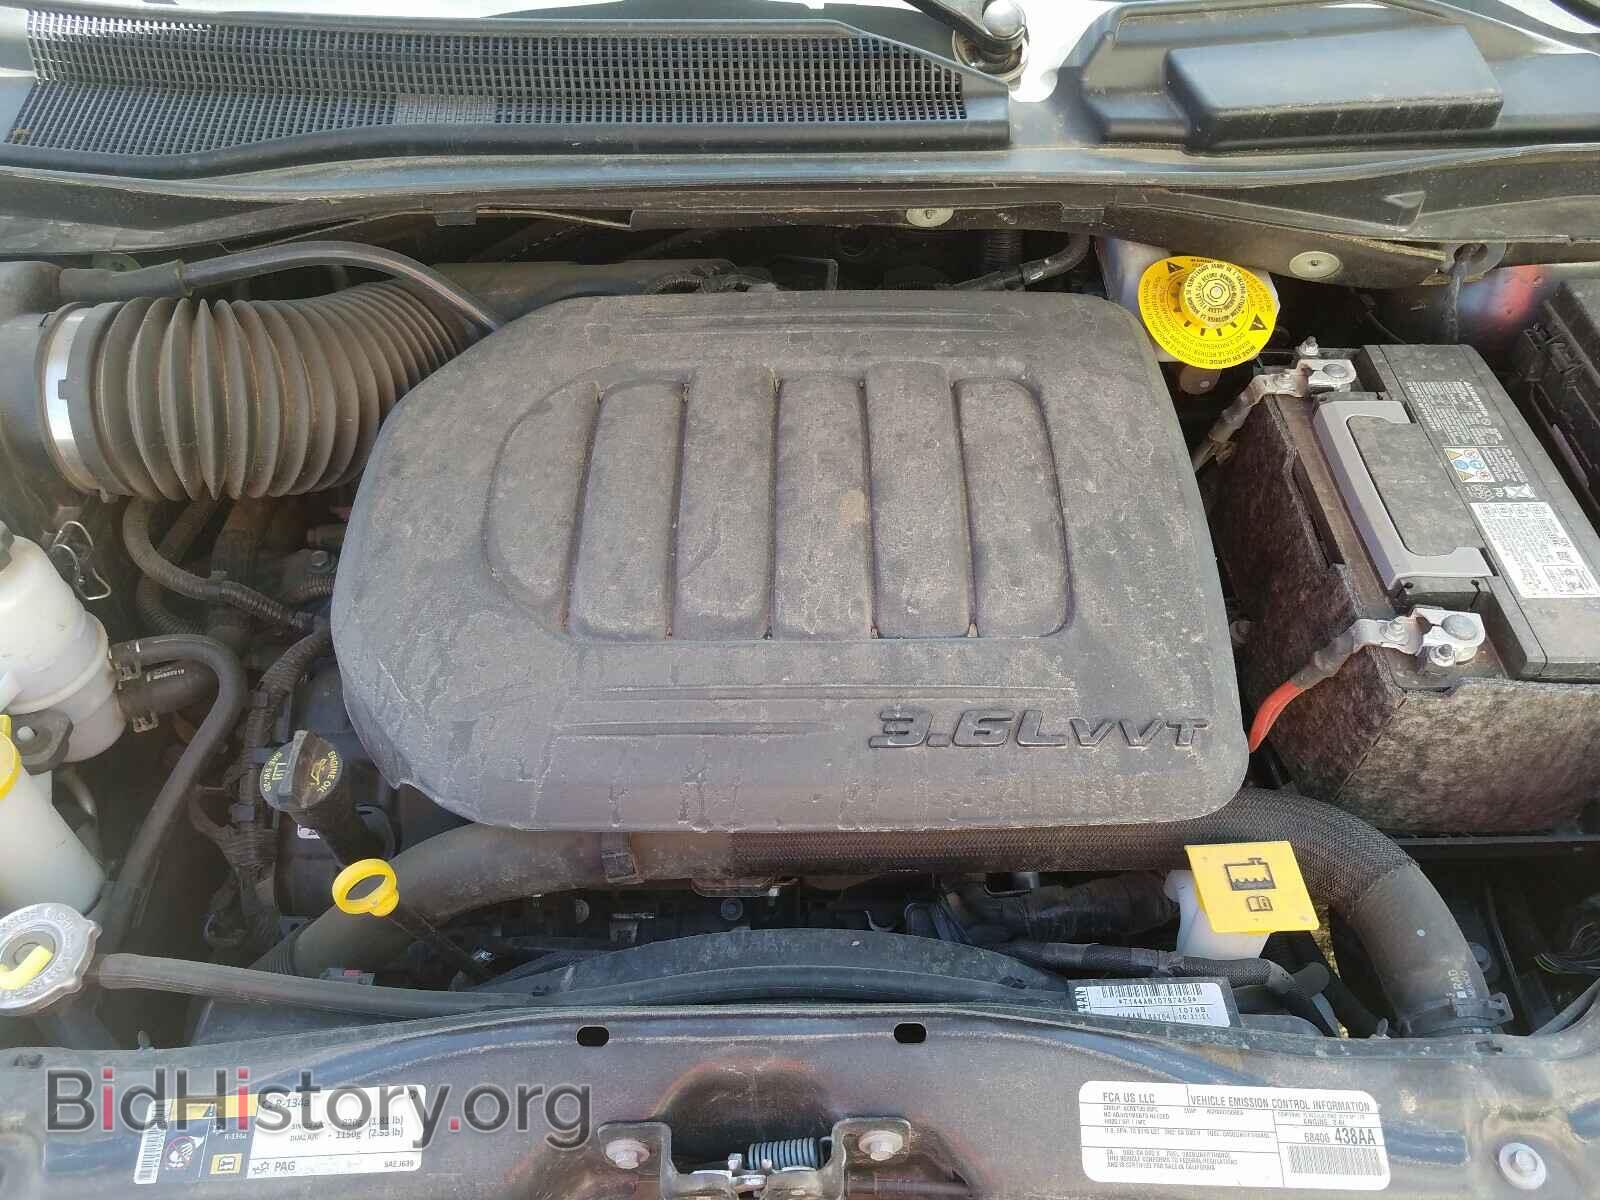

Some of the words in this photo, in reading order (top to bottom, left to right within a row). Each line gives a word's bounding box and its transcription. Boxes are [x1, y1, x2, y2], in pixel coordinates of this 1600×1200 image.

[1069, 716, 1209, 750] VVT
[327, 750, 337, 780] ENGINE
[317, 780, 332, 793] OIL
[1103, 1092, 1121, 1103] FCA
[1123, 1092, 1136, 1103] US
[1138, 1093, 1155, 1104] LLC
[1190, 1095, 1225, 1106] VEHICLE
[1228, 1096, 1269, 1108] EMISSION
[1271, 1098, 1311, 1110] CONTROL
[1312, 1099, 1370, 1112] INFORMATION
[1335, 1127, 1376, 1145] 438AA
[274, 1160, 296, 1172] PAG
